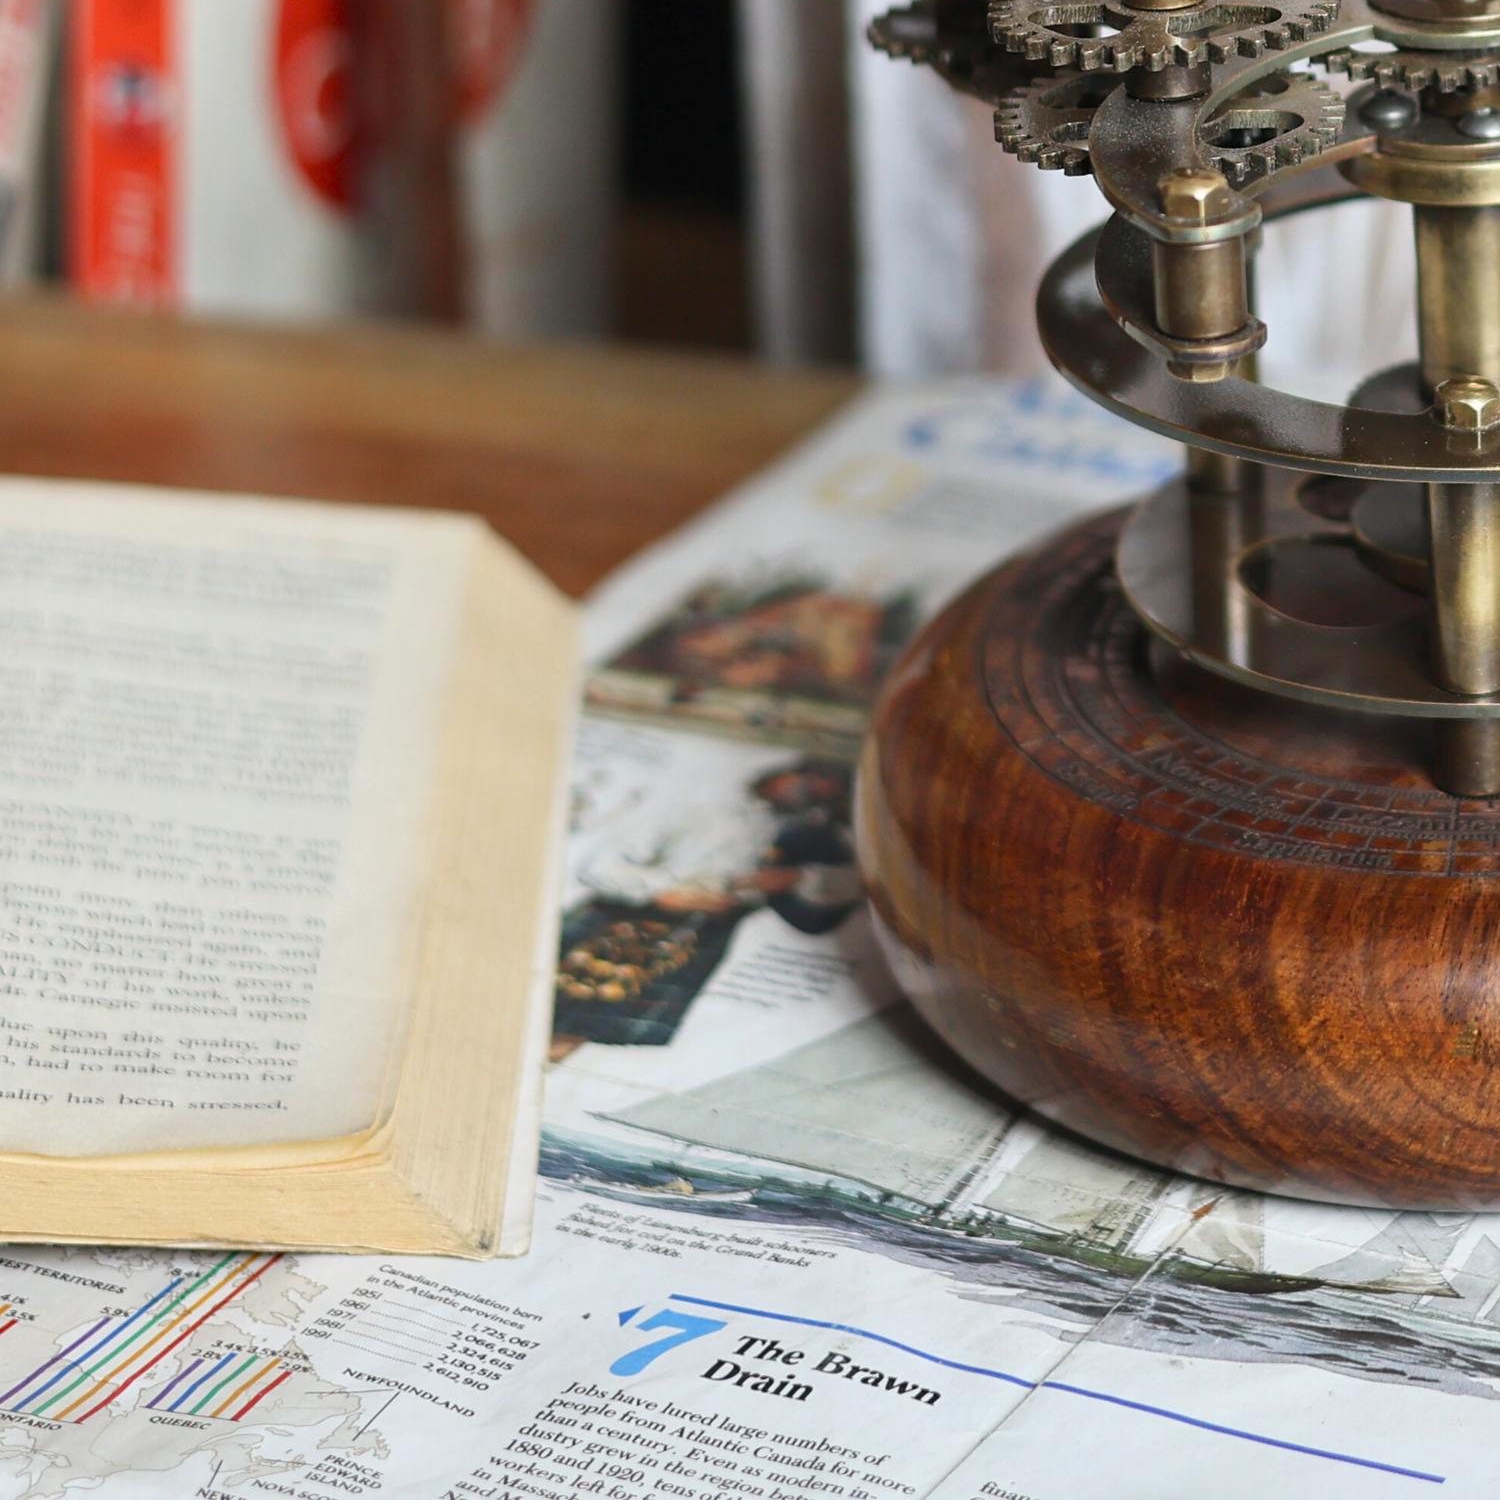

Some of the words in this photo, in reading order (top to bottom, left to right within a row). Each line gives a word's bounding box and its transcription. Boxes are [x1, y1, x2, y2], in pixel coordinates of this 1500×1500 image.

[7, 1036, 39, 1050] his
[50, 1042, 161, 1060] standards
[172, 1051, 195, 1063] to
[207, 1052, 298, 1068] become
[27, 1055, 69, 1071] had
[80, 1061, 104, 1073] to
[112, 1062, 177, 1076] make
[186, 1070, 250, 1082] room
[261, 1071, 295, 1083] for
[67, 1092, 105, 1106] has
[119, 1094, 174, 1108] been
[33, 1266, 127, 1295] TERRITORIES
[352, 1287, 383, 1300] 1951
[379, 1264, 439, 1290] Canadian
[439, 1285, 510, 1313] population
[512, 1307, 543, 1322] born
[6, 1309, 38, 1320] 3.5%
[100, 1306, 130, 1318] 5.9%
[326, 1308, 357, 1320] 1971
[339, 1298, 371, 1311] 1961
[366, 1274, 381, 1284] in
[383, 1278, 405, 1291] the
[407, 1285, 460, 1308] Atlantic
[460, 1304, 526, 1331] provinces
[300, 1327, 333, 1341] 1991
[313, 1317, 346, 1331] 1981
[609, 1308, 729, 1377] 7
[700, 1358, 814, 1402] Drain
[732, 1335, 806, 1366] The
[812, 1350, 943, 1407] Brawn
[342, 1368, 475, 1418] NEWFOUNDLAND
[149, 1416, 211, 1430] QUEBEC
[561, 1381, 609, 1399] Jobs
[611, 1389, 658, 1411] have
[662, 1401, 718, 1426] lured
[718, 1417, 769, 1440] large
[771, 1432, 861, 1460] numbers
[863, 1454, 891, 1467] of
[518, 1423, 583, 1450] dustry
[582, 1441, 637, 1462] grew
[639, 1454, 659, 1468] in
[663, 1460, 697, 1477] the
[700, 1471, 764, 1497] region
[534, 1409, 578, 1429] than
[580, 1421, 594, 1431] a
[596, 1422, 677, 1455] century.
[686, 1447, 738, 1471] Even
[743, 1465, 764, 1477] as
[765, 1469, 846, 1495] modern
[547, 1398, 617, 1419] people
[618, 1411, 667, 1434] from
[669, 1426, 749, 1454] Atlantic
[753, 1445, 827, 1472] Canada
[828, 1459, 860, 1477] for
[862, 1473, 916, 1496] more
[313, 1463, 382, 1490] EDWARD
[323, 1454, 383, 1479] PRINCE
[471, 1468, 492, 1481] in
[489, 1456, 568, 1488] workers
[570, 1475, 605, 1493] left
[503, 1439, 554, 1460] 1880
[553, 1454, 595, 1472] and
[594, 1462, 645, 1486] 1920,
[653, 1478, 697, 1498] tens
[251, 1479, 296, 1496] NOVA
[304, 1471, 363, 1495] ISLAND
[455, 1480, 498, 1497] and
